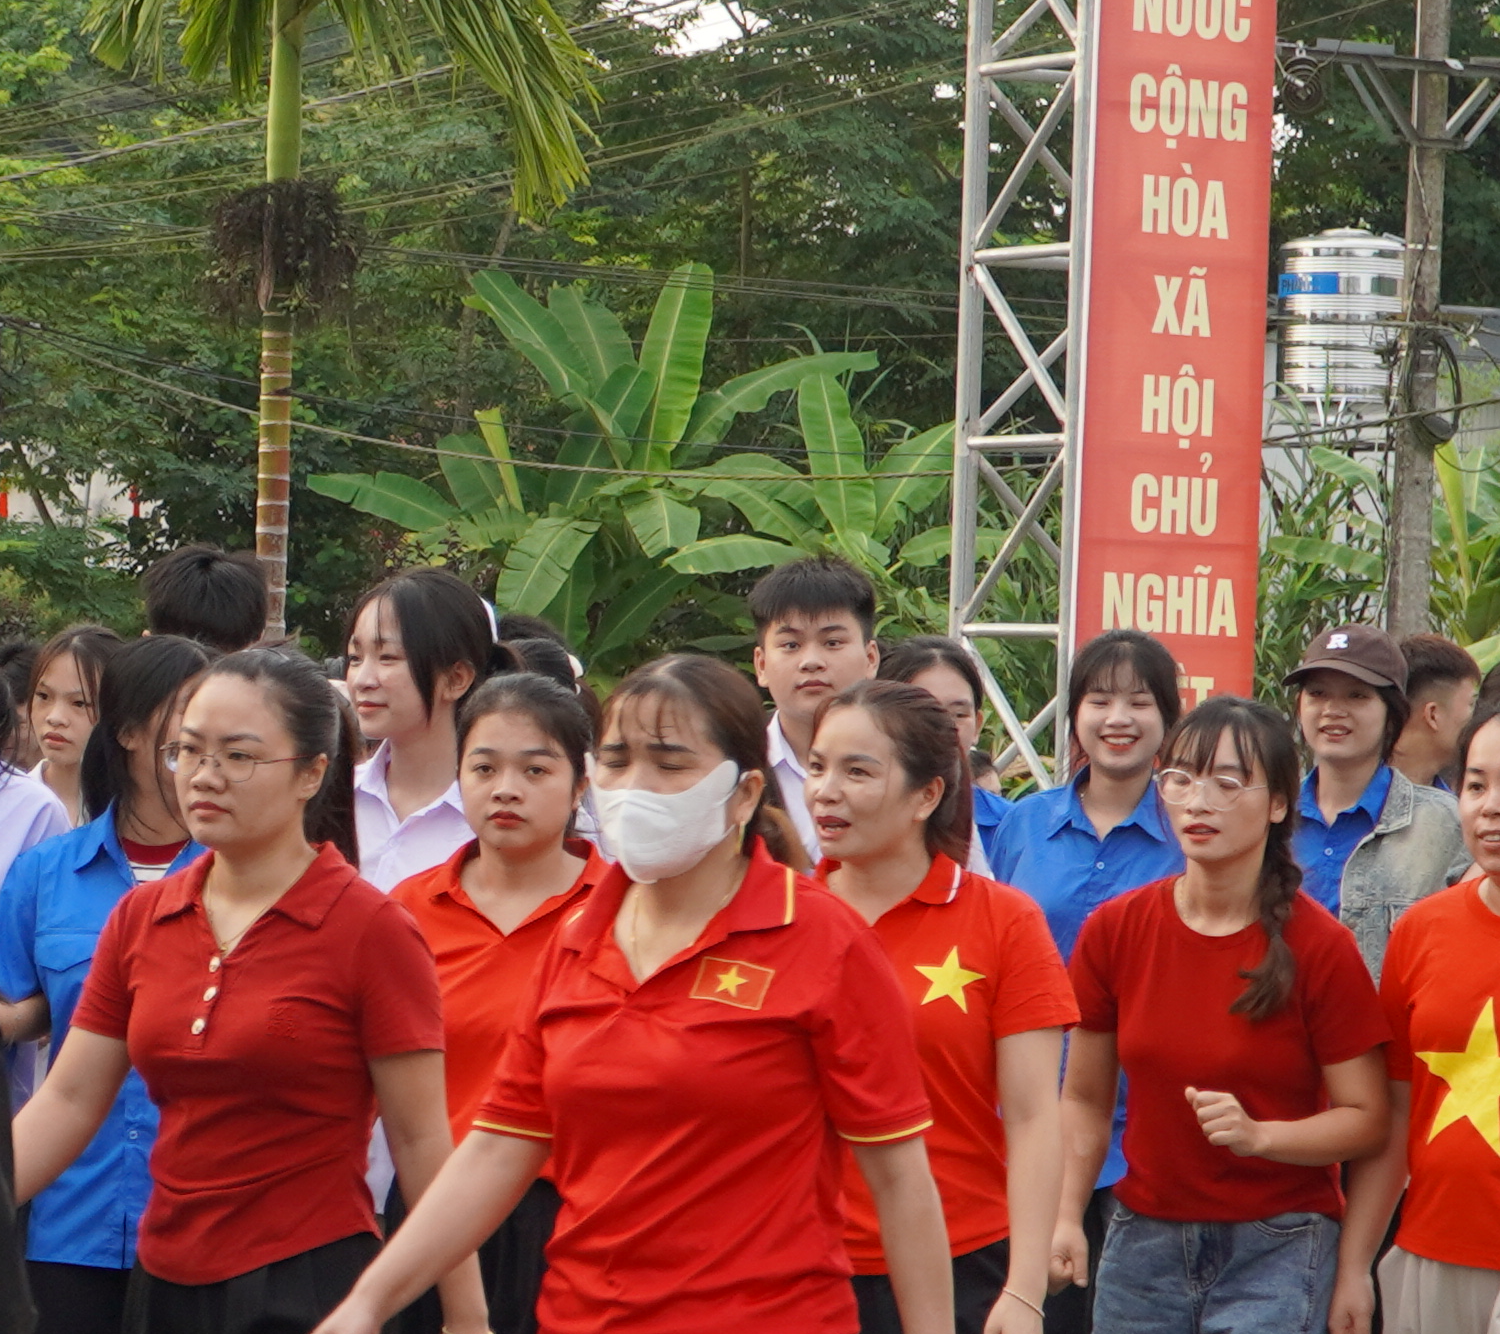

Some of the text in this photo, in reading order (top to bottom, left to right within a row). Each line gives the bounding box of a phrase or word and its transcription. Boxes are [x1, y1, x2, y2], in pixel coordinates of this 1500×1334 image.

[1129, 63, 1250, 151] CỘNG
[1141, 162, 1231, 242] HÒA
[1151, 267, 1213, 340] XÃ
[1141, 364, 1217, 451] HỘI
[1130, 452, 1221, 540] CHỦ
[1102, 564, 1240, 639] NGHĨA
[1325, 633, 1349, 650] R
